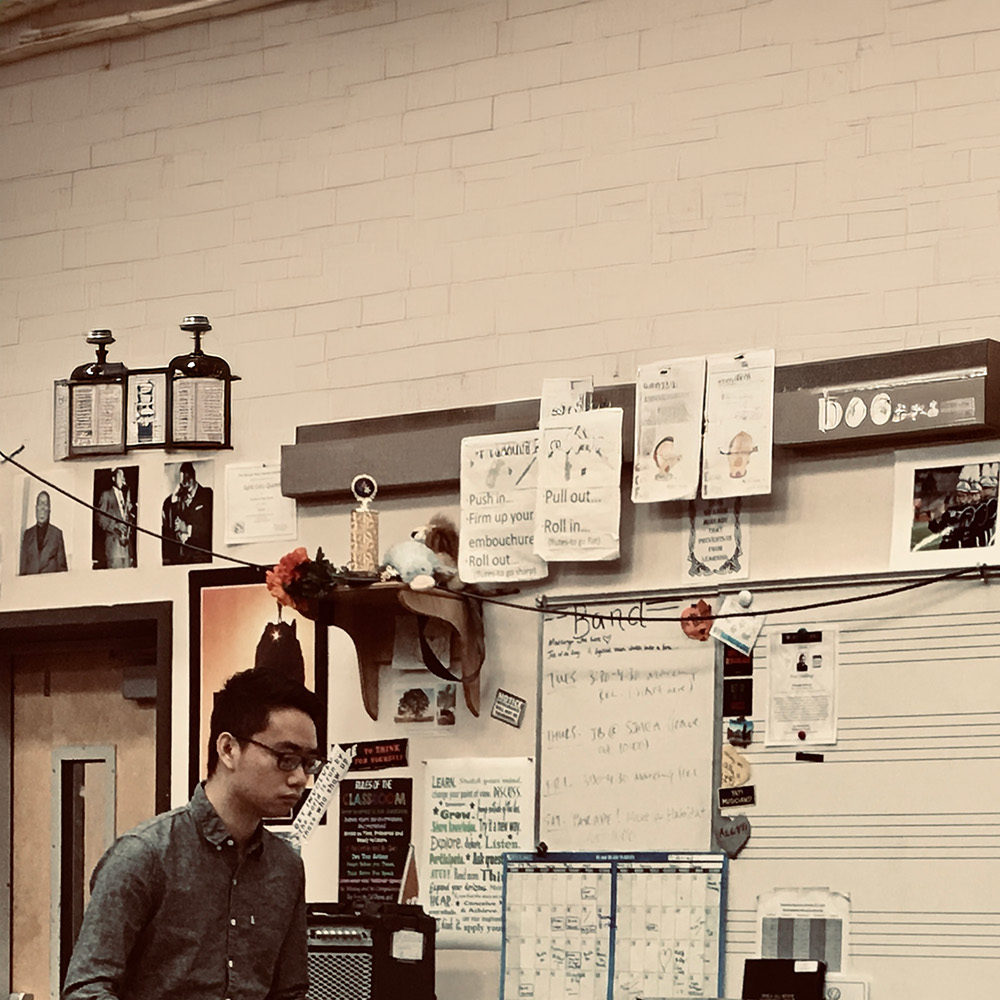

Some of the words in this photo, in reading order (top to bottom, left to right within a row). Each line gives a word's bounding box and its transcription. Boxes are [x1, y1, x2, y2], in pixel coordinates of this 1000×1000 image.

[469, 493, 494, 507] Push
[545, 489, 568, 505] Pull
[469, 513, 492, 525] Firm
[494, 510, 508, 527] up
[511, 510, 534, 526] your
[544, 519, 567, 534] Roll
[468, 534, 535, 549] embouchure
[469, 554, 490, 567] Roll
[573, 602, 647, 639] Band
